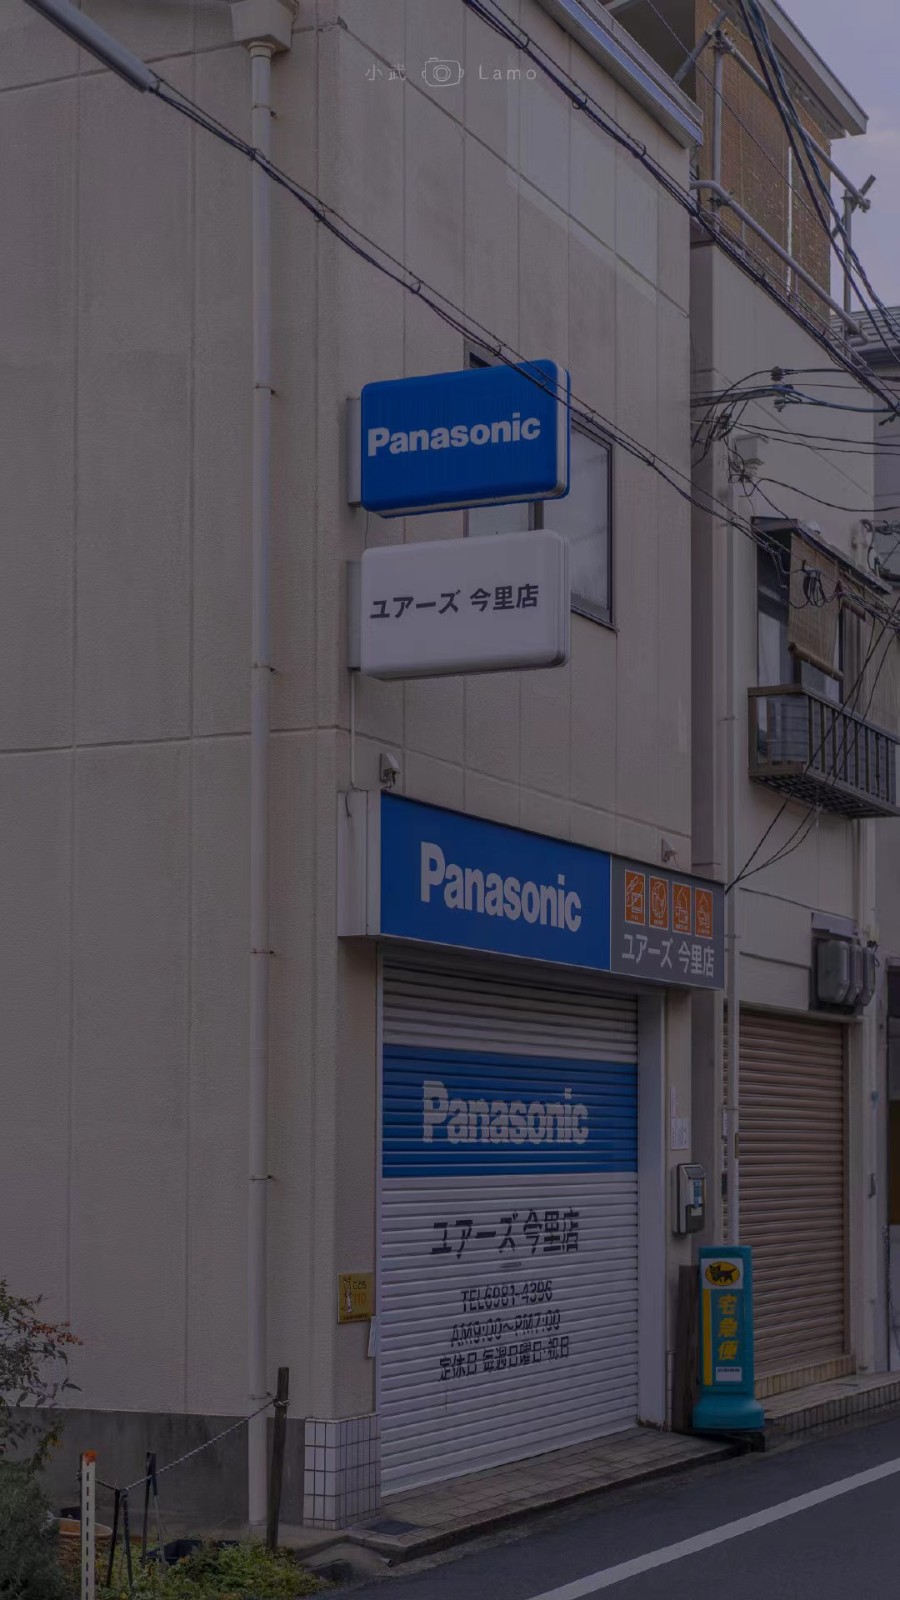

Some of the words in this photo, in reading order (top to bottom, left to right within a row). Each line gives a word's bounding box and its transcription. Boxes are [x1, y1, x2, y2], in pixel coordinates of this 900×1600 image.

[367, 411, 541, 456] Panasonic
[369, 589, 461, 619] ユアーズ
[469, 583, 539, 611] 今里店
[420, 841, 582, 932] Panasonic
[621, 933, 673, 969] ユアーズ
[678, 940, 715, 977] 今里店
[422, 1080, 589, 1144] Panasonic
